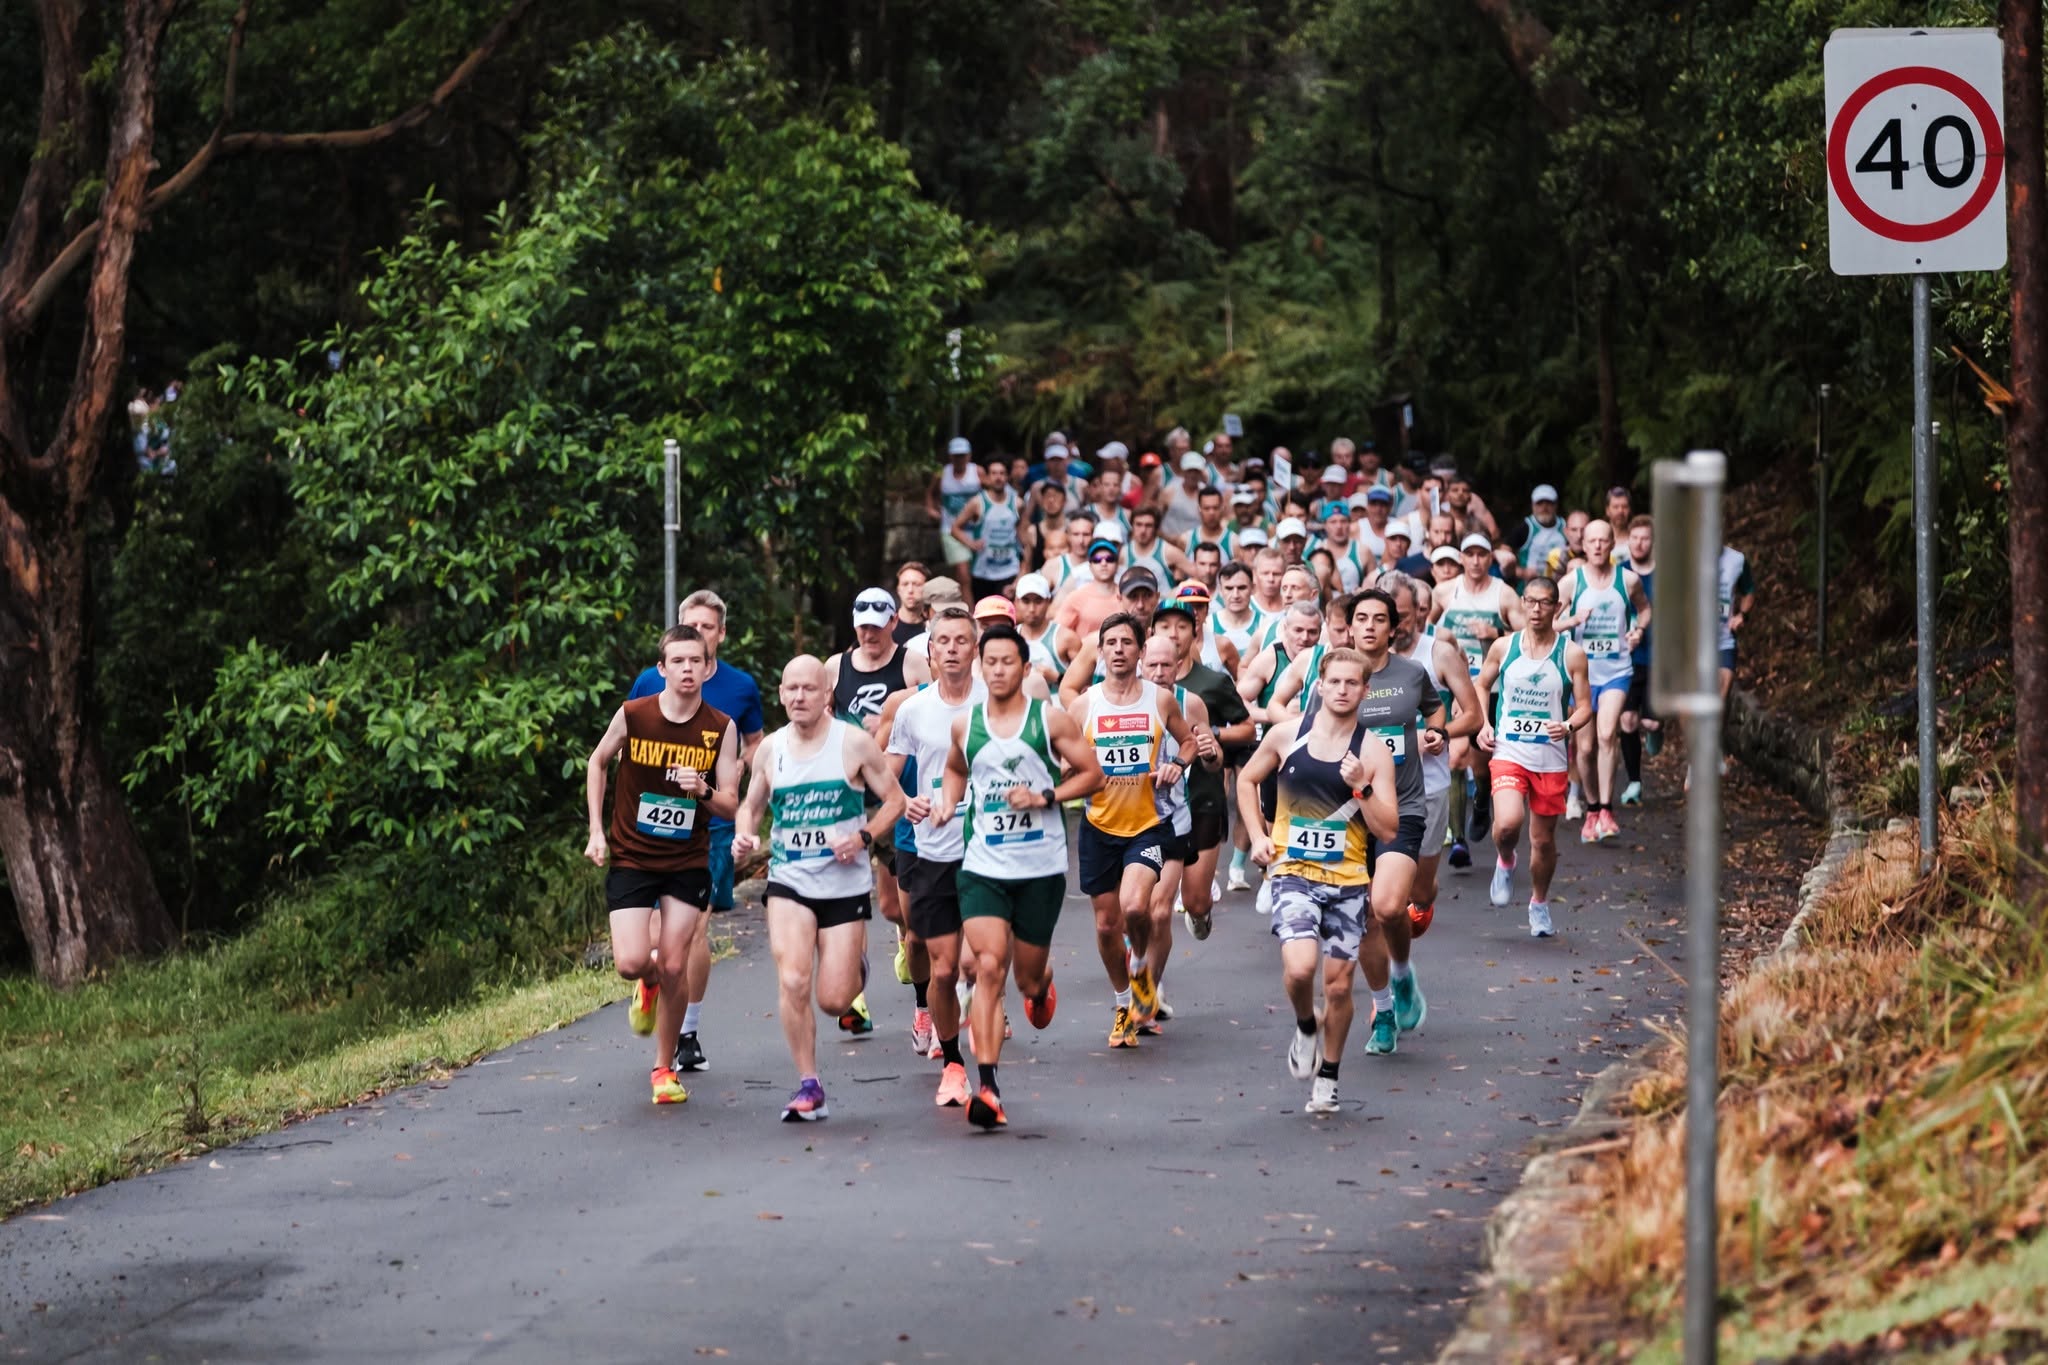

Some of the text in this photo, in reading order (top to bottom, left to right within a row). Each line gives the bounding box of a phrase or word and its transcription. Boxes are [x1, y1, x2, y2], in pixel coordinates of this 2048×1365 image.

[1855, 115, 1976, 190] 40
[1588, 640, 1612, 651] 452
[1514, 686, 1550, 698] Sydney
[1511, 695, 1549, 707] Striders
[1513, 720, 1542, 733] 367
[630, 738, 717, 770] HAWTHORN
[1105, 747, 1140, 764] 418
[785, 788, 844, 806] Sydney
[646, 807, 686, 826] 420
[993, 812, 1033, 832] 374
[792, 830, 827, 847] 478
[1297, 830, 1336, 849] 415
